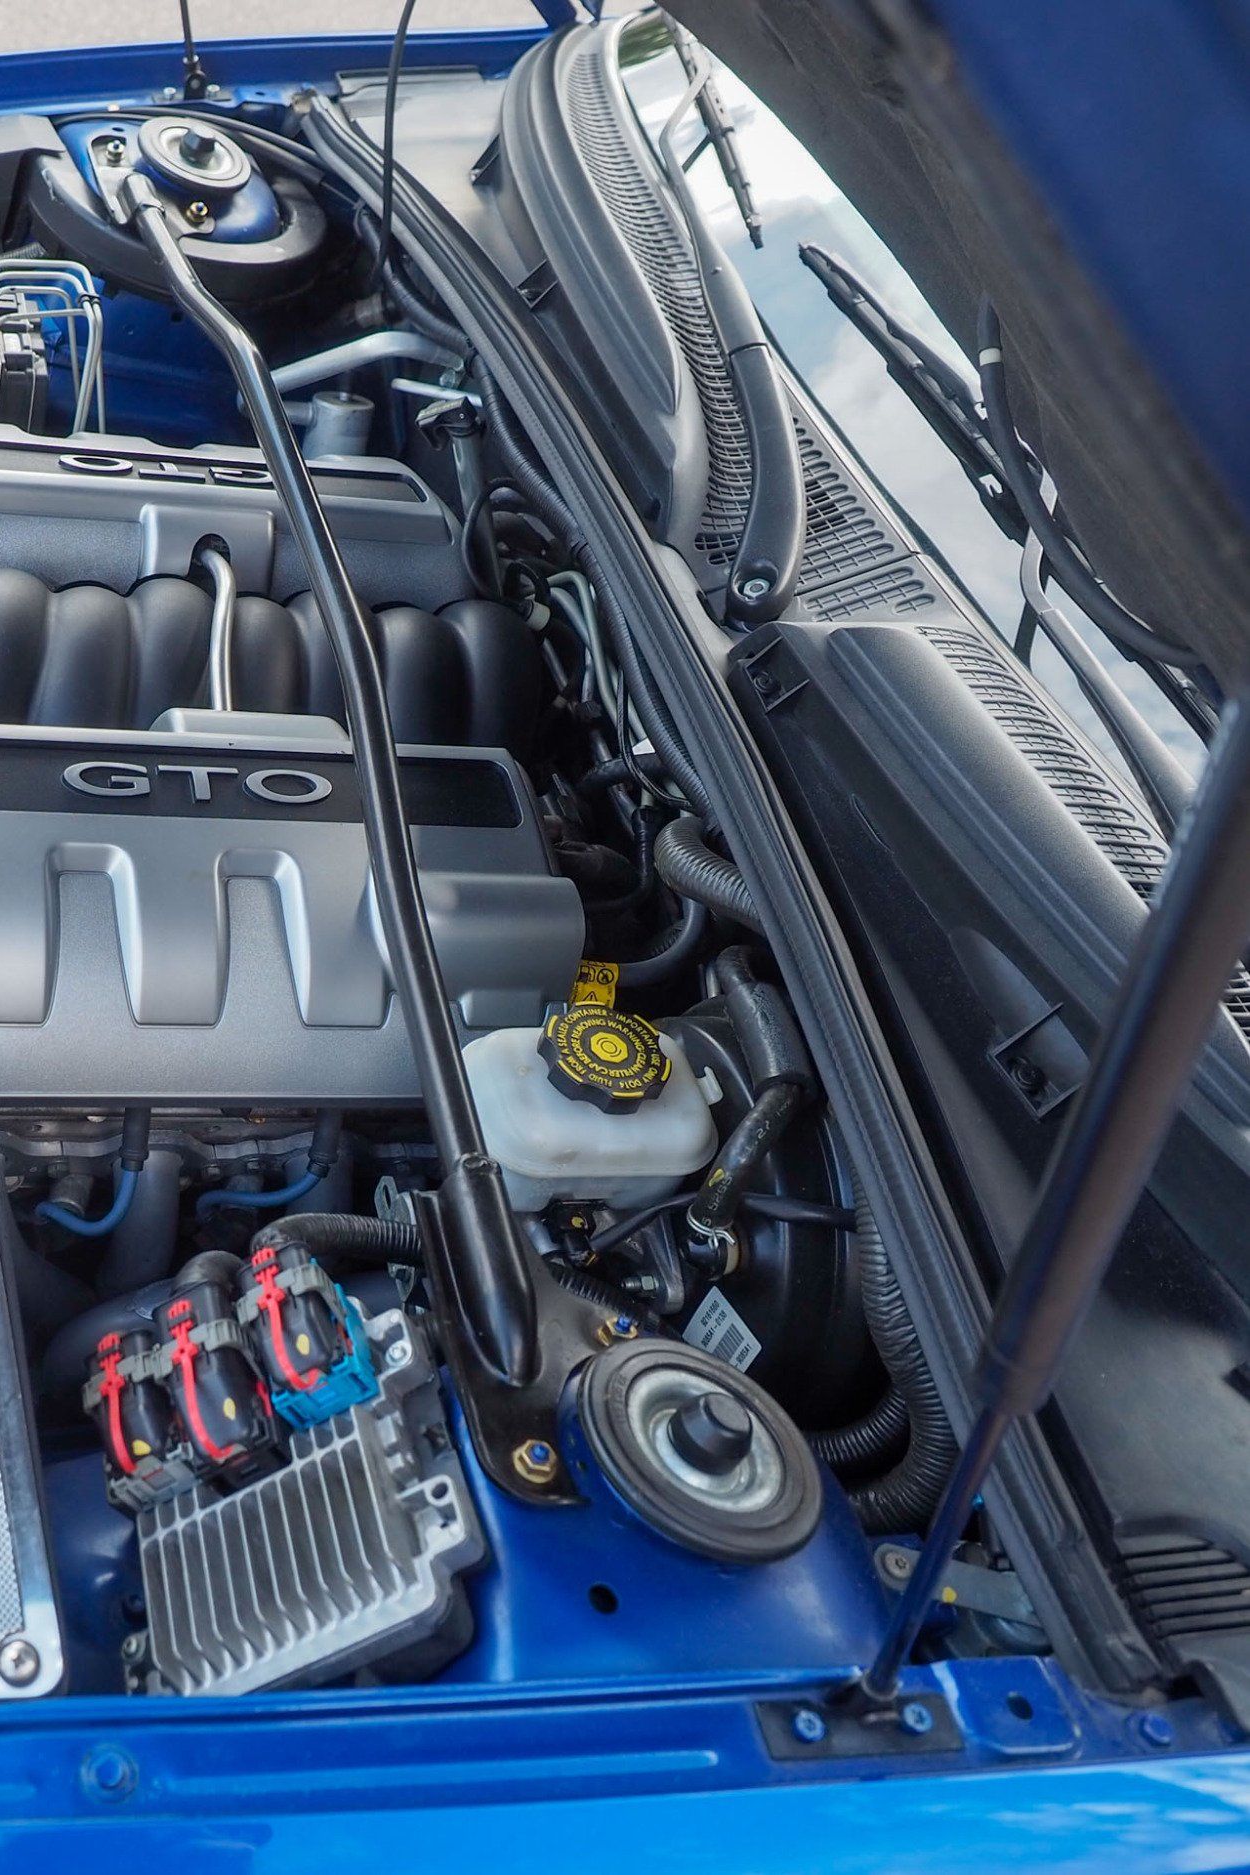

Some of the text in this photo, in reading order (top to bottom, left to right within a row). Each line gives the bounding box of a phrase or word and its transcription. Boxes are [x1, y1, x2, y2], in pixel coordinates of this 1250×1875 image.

[61, 761, 333, 804] GTO
[564, 1008, 608, 1024] CONTAINER
[557, 1022, 569, 1047] SEALED
[616, 1013, 658, 1050] IMPORTANT
[566, 1056, 587, 1075] FROM
[589, 1060, 608, 1075] CAP
[588, 1074, 612, 1087] FLUID
[643, 1067, 658, 1083] ONLY
